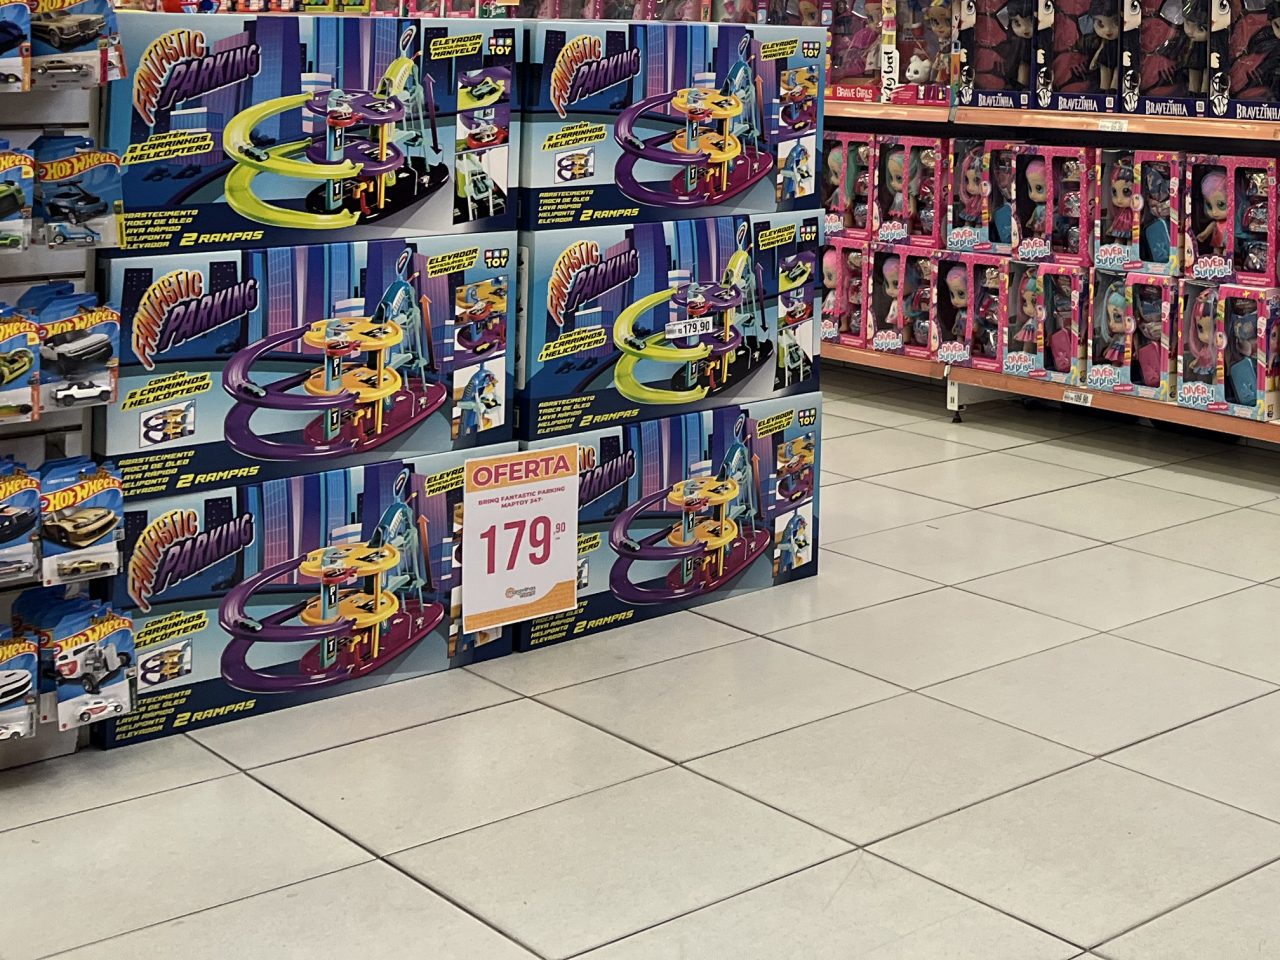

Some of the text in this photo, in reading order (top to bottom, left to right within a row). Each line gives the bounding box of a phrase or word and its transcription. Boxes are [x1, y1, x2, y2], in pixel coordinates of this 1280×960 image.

[431, 35, 482, 46] ELEVADOR
[431, 47, 477, 58] MANIVELA
[489, 45, 511, 55] TOY
[133, 29, 206, 126] FANTASTIC
[162, 40, 260, 107] PARKING
[551, 34, 602, 118] FANTASTIC
[569, 48, 641, 103] PARKING
[140, 134, 209, 150] CARRINHOS
[149, 131, 187, 142] CONTÉM
[129, 143, 211, 161] HELICÓPTERO
[181, 230, 264, 245] 2 RAMPAS
[132, 270, 204, 370] FANTASTIC
[158, 280, 257, 351] PARKING
[580, 409, 639, 427] 2 RAMPAS
[473, 455, 570, 485] OFERTA
[478, 487, 565, 506] BRINQ FANTASTIC PARKING
[501, 500, 528, 508] MAPTOY
[480, 516, 551, 574] 179
